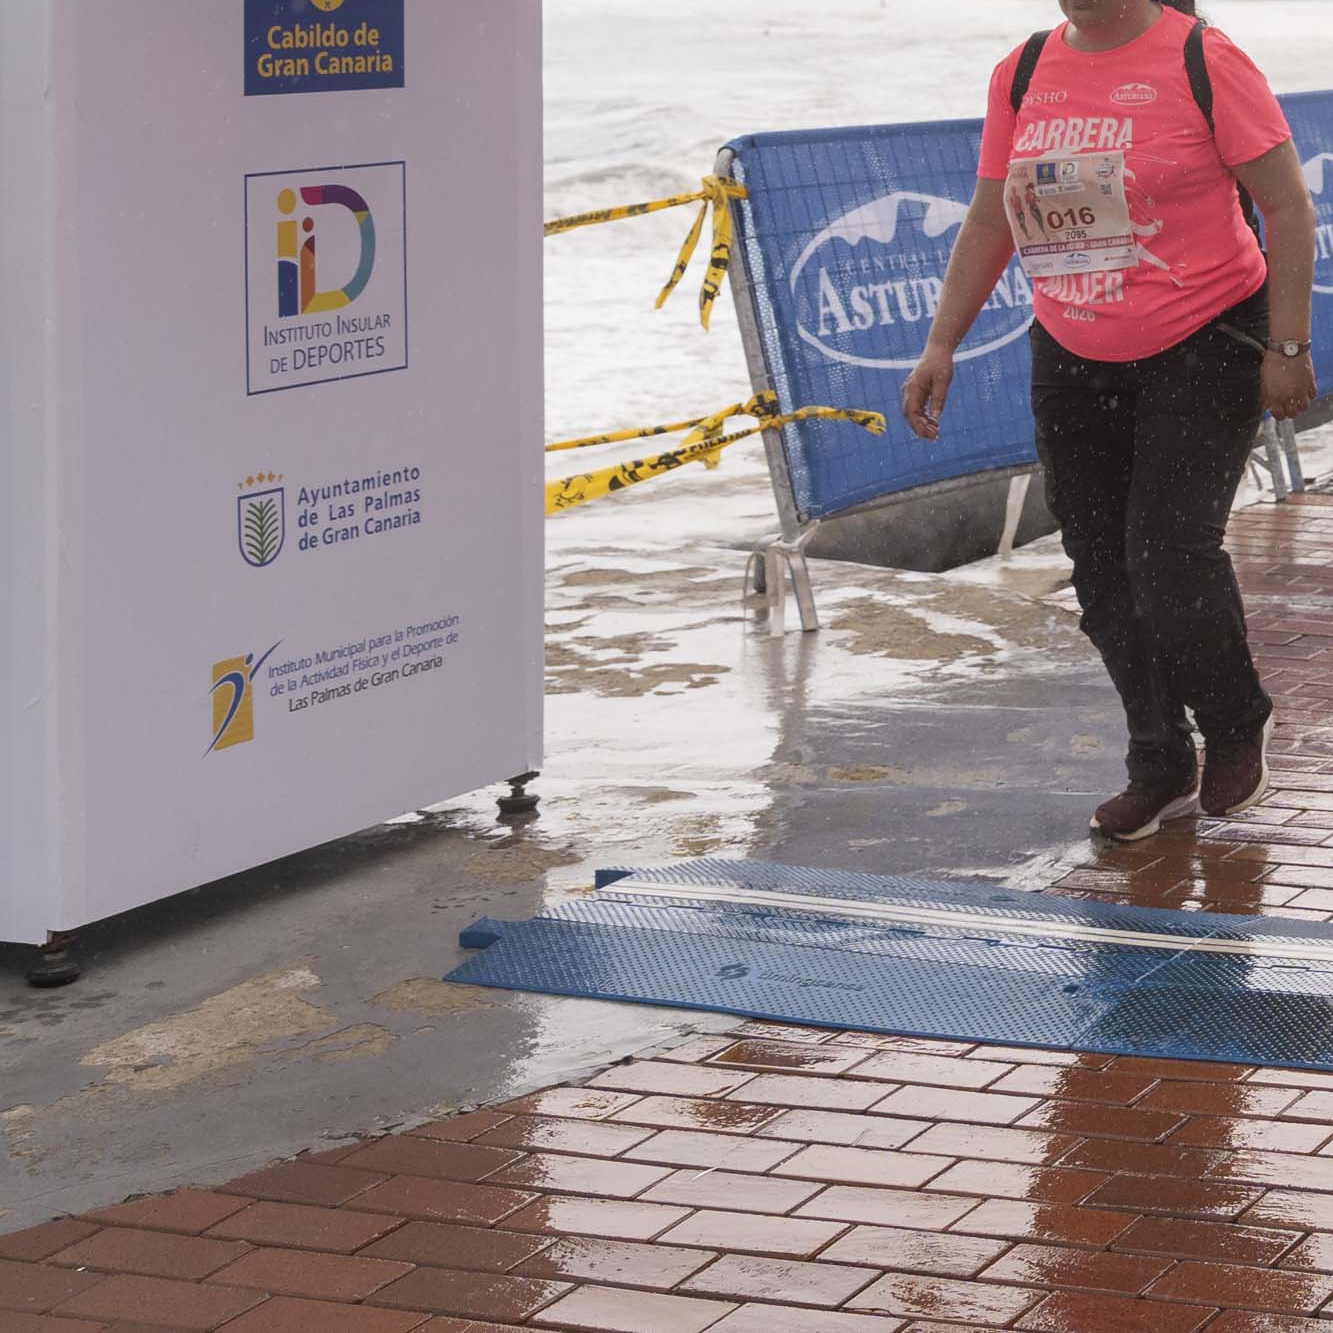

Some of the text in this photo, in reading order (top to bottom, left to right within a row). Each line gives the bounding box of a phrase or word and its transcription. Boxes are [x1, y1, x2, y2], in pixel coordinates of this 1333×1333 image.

[267, 22, 380, 50] Cabildo de
[257, 49, 393, 78] Gran Canaria
[1015, 118, 1133, 152] CARRERA
[1047, 206, 1095, 230] 016
[264, 313, 391, 347] INSTITUTO INSULAR
[270, 336, 385, 374] DE DEPORTES
[297, 467, 420, 508] Ayuntamiento
[298, 488, 420, 528] de Las Palmas
[299, 510, 421, 551] de Gran Canaria
[268, 615, 459, 679] Instituto Municipal para la Promoción
[270, 631, 459, 697] de la Actividad Física y el Deporte de
[288, 656, 443, 712] Las Palmas de Gran Canaria
